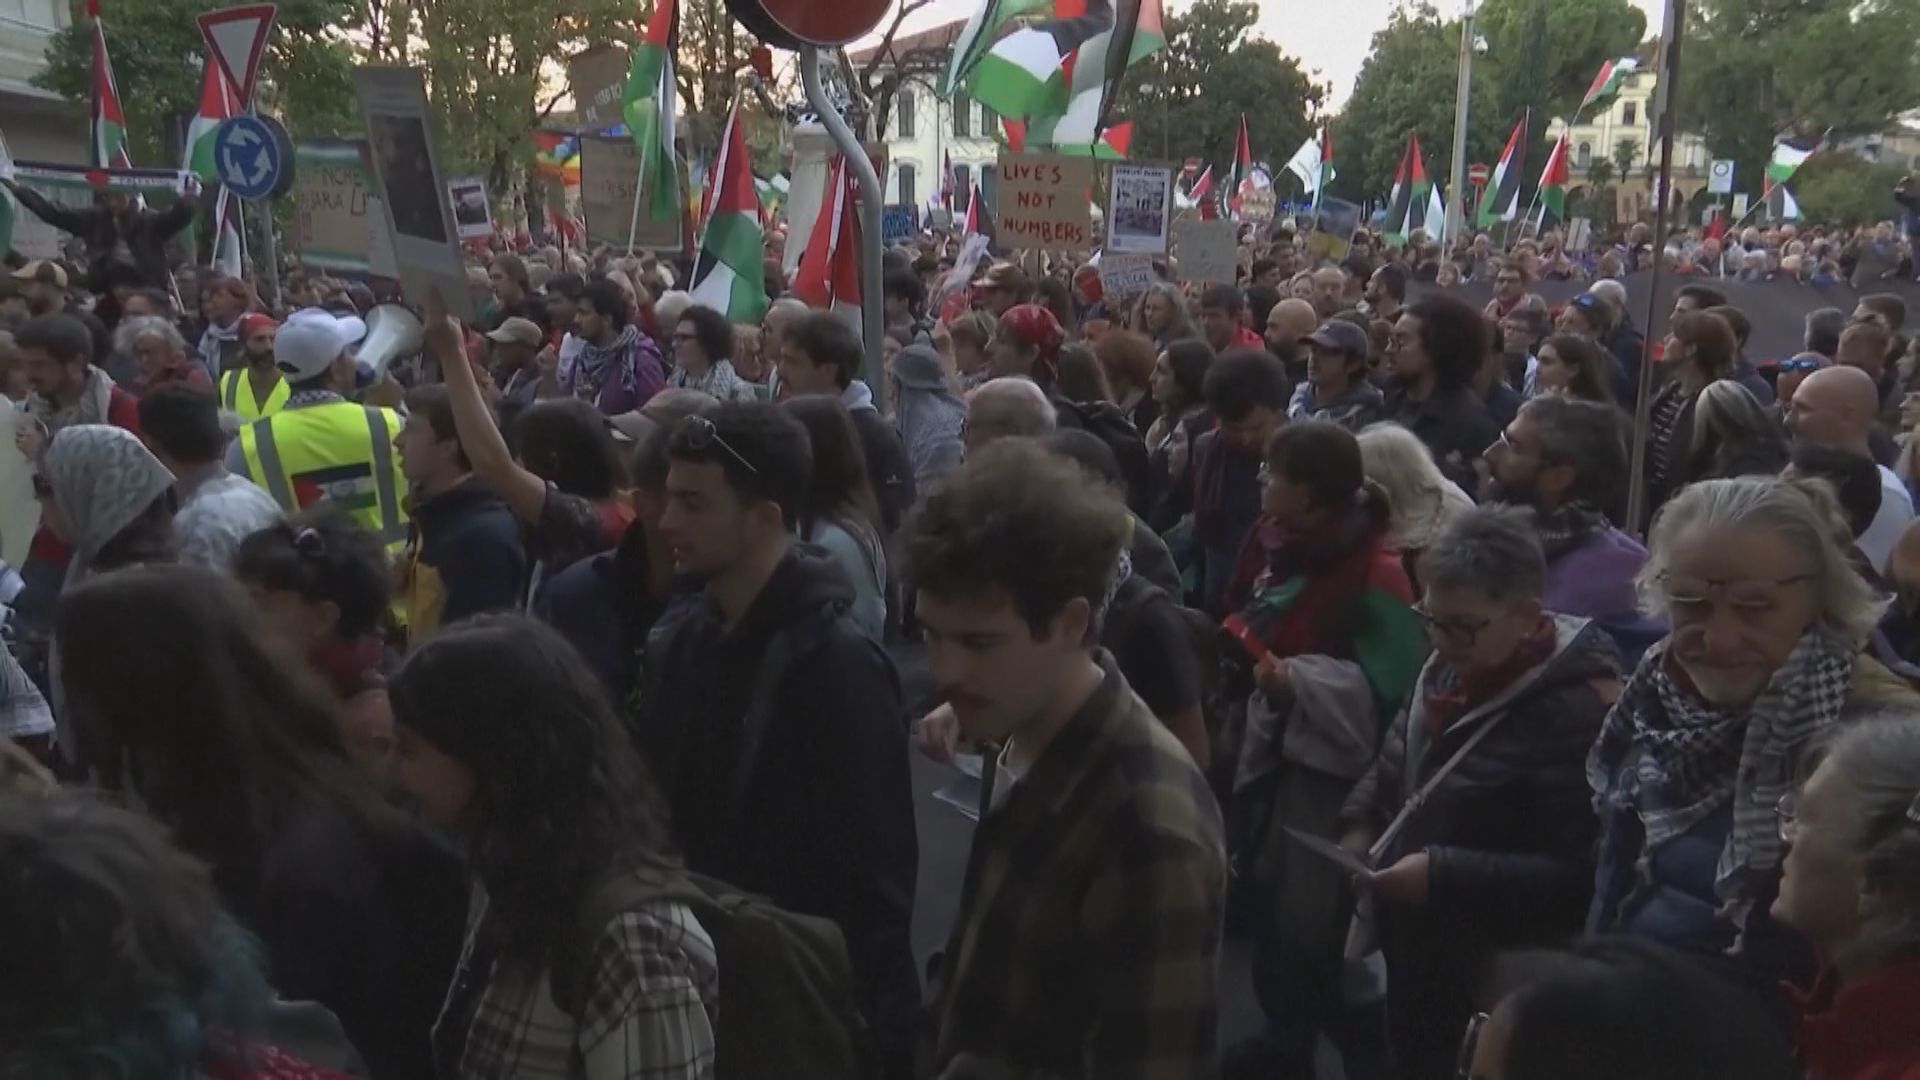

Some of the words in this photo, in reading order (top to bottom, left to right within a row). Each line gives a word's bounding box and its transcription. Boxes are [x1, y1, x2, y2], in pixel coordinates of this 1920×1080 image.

[1003, 162, 1063, 184] LIVES
[1017, 190, 1057, 209] NOT
[1003, 216, 1083, 244] NUMBERS
